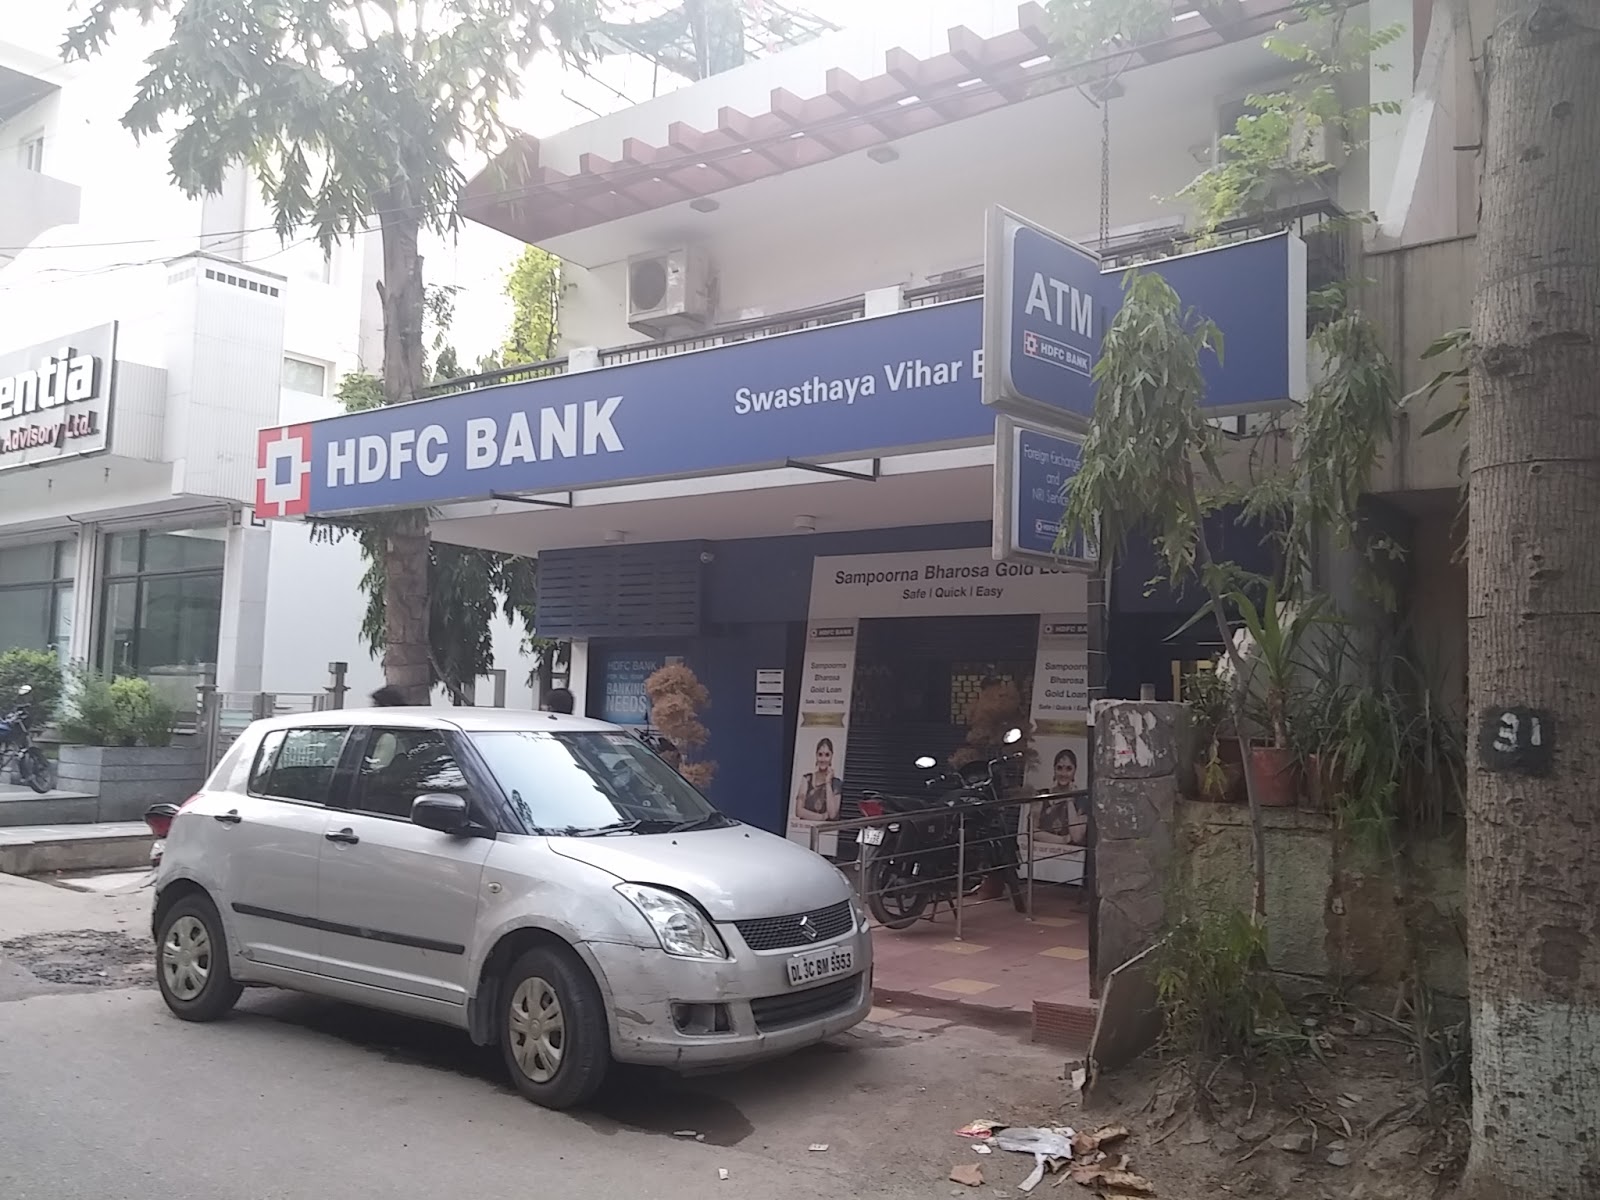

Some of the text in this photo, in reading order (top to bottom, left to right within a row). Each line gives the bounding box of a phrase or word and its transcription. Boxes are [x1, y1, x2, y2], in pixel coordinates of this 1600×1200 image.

[1024, 271, 1093, 339] ATM
[1040, 342, 1088, 370] HDFC BANK
[735, 375, 876, 415] Swasthaya
[884, 359, 963, 391] Vihar
[3, 423, 61, 450] Advisory
[327, 396, 624, 488] HDFC BANK
[1023, 443, 1081, 472] Foreign Exchange
[1046, 471, 1060, 485] and
[1032, 487, 1045, 501] NRI
[835, 569, 919, 586] Sampoorna
[924, 564, 990, 580] Bharosa
[995, 562, 1034, 577] Gold
[902, 588, 926, 600] Safe
[935, 586, 967, 599] Quick
[976, 586, 1004, 599] Easy
[1055, 625, 1088, 633] HDFC BA
[607, 660, 657, 671] HDFC BANK
[811, 662, 847, 670] Sampoorna
[1044, 662, 1088, 671] Sampoorn
[1050, 676, 1085, 684] Bharosa
[606, 682, 647, 695] BANKING
[810, 686, 826, 694] Gold
[1044, 689, 1087, 698] Gold Loan
[605, 695, 647, 713] NEEDS
[791, 953, 851, 981] DL 3C BM 5553
